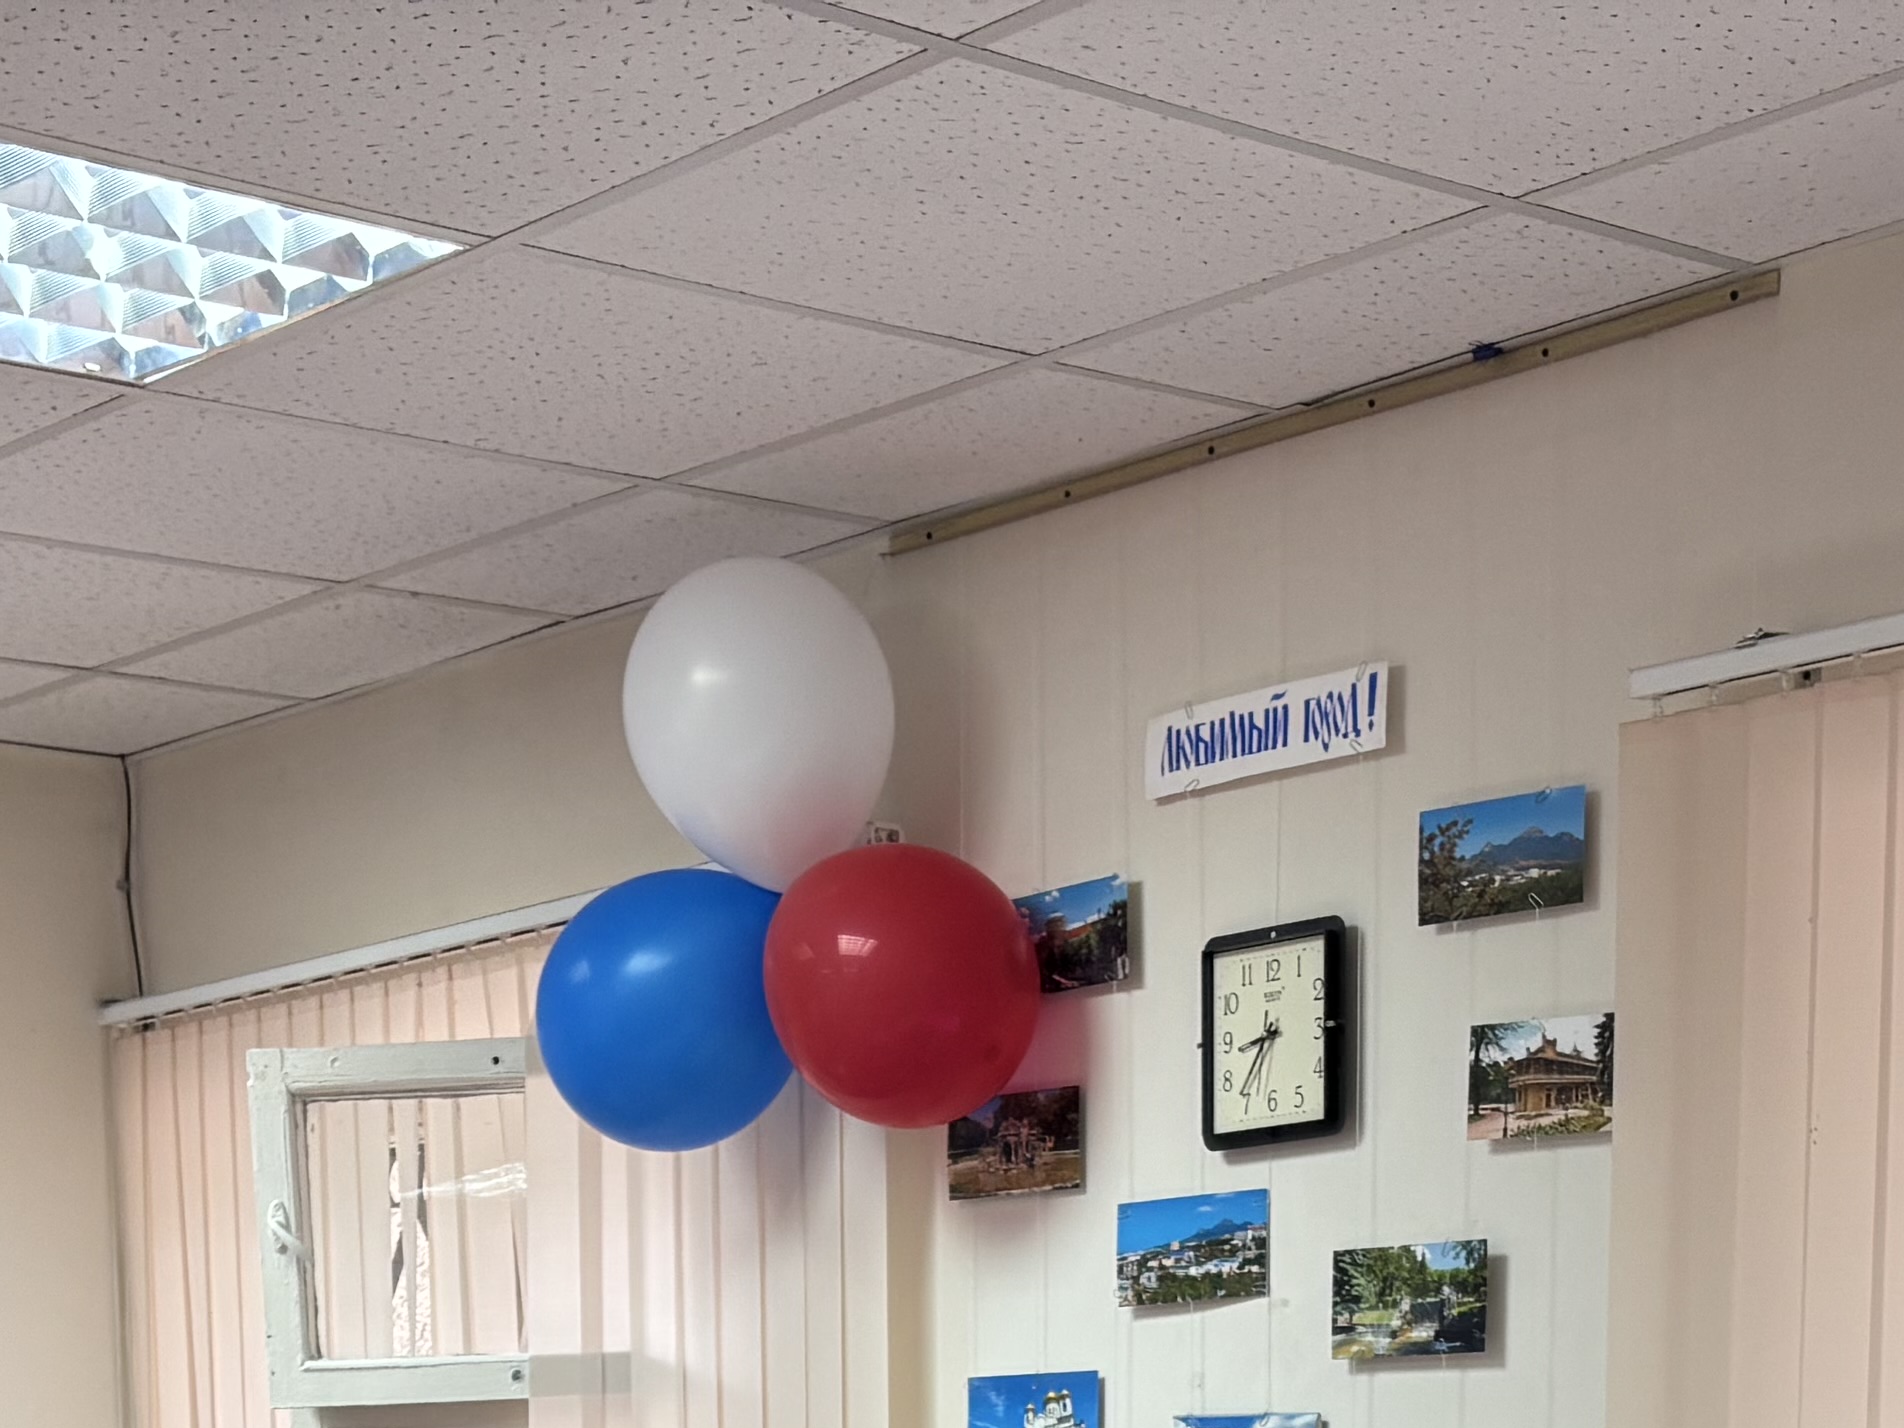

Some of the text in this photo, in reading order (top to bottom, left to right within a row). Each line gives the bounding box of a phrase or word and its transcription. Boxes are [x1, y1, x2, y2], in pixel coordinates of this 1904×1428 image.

[1241, 955, 1302, 987] 11 12 1
[1312, 977, 1325, 1001] 2
[1223, 992, 1239, 1016] 10
[1313, 1016, 1325, 1040] 3
[1223, 1031, 1234, 1054] 9
[1313, 1056, 1324, 1079] 4
[1222, 1070, 1233, 1093] 8
[1241, 1092, 1252, 1115] 7
[1267, 1089, 1278, 1113] 6
[1294, 1085, 1304, 1109] 5
